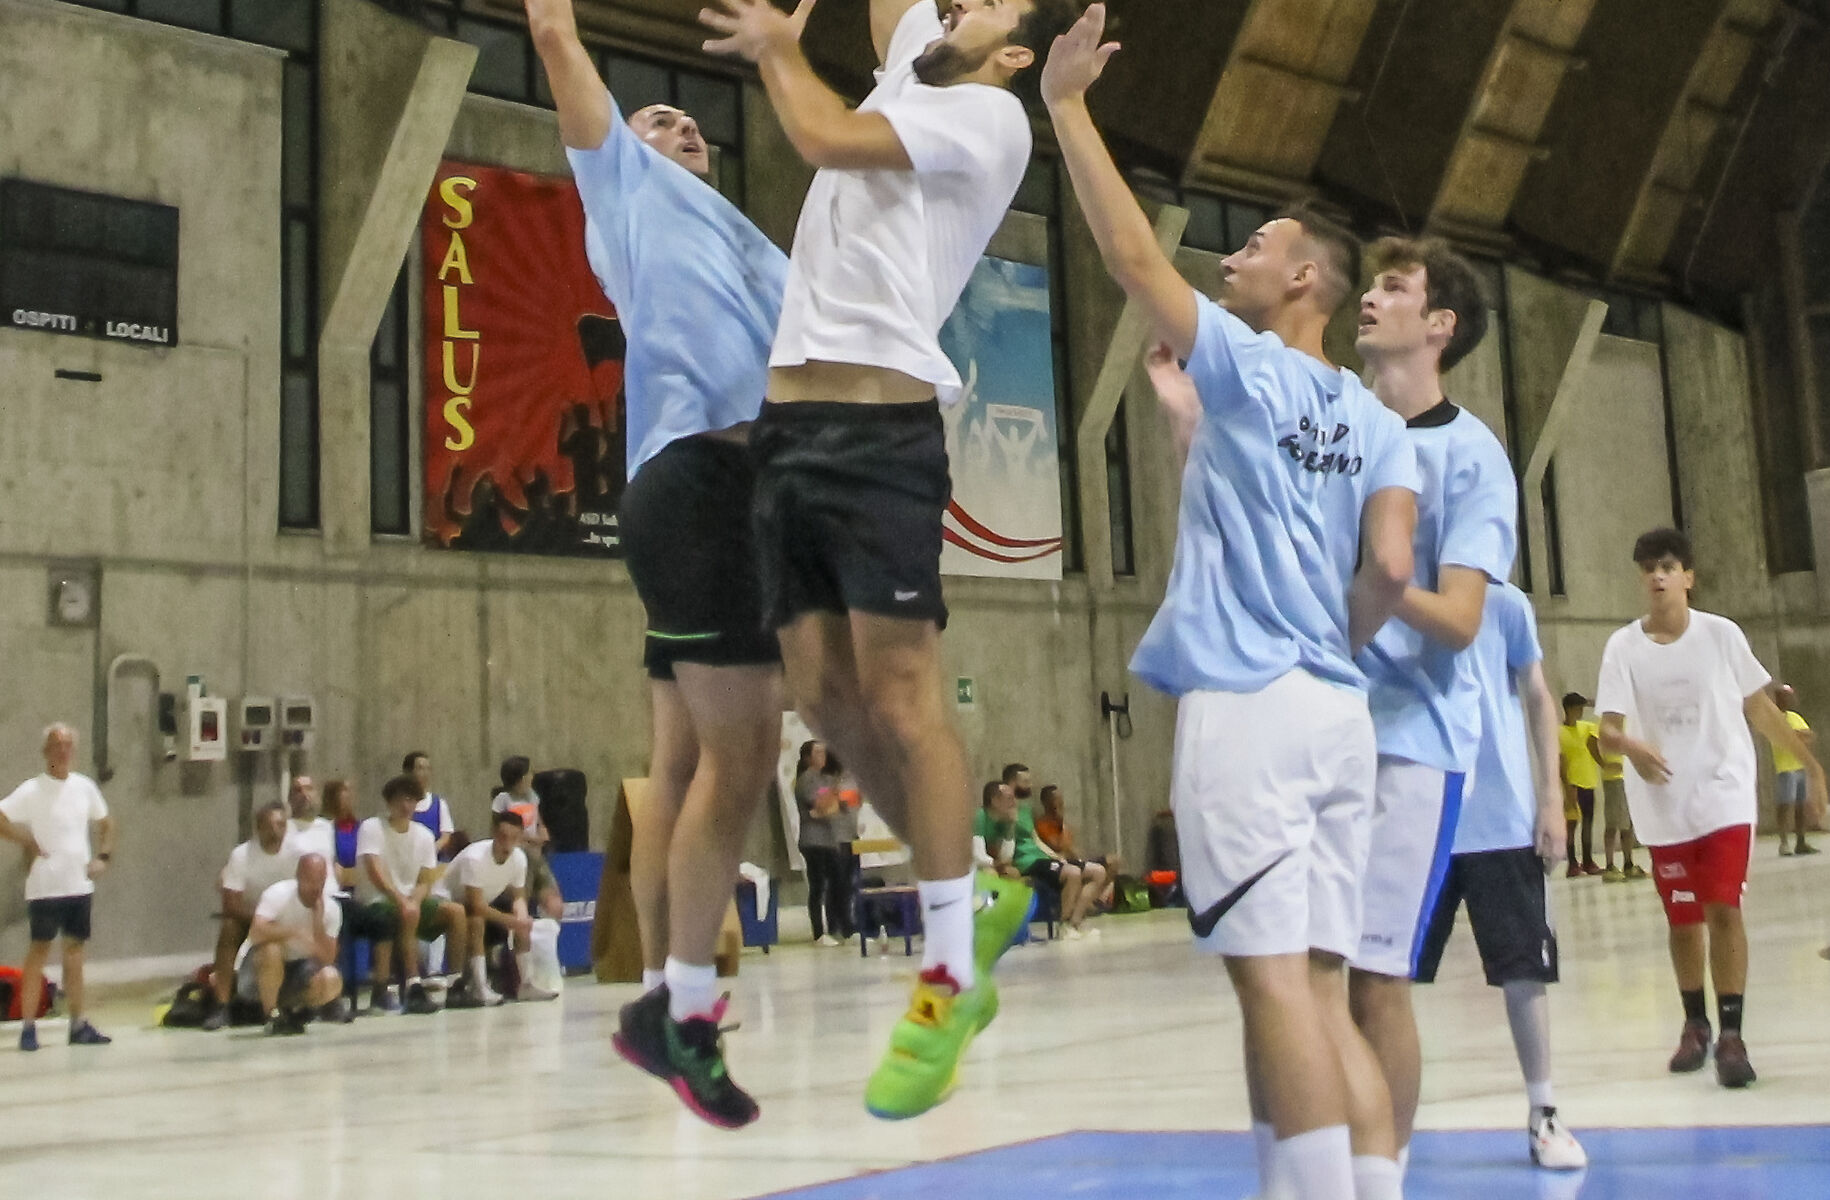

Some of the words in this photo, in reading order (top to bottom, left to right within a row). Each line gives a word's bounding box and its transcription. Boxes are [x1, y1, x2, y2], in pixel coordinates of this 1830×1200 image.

[12, 308, 77, 331] OSPITI
[438, 176, 481, 452] SALUS
[106, 321, 169, 343] LOCALI
